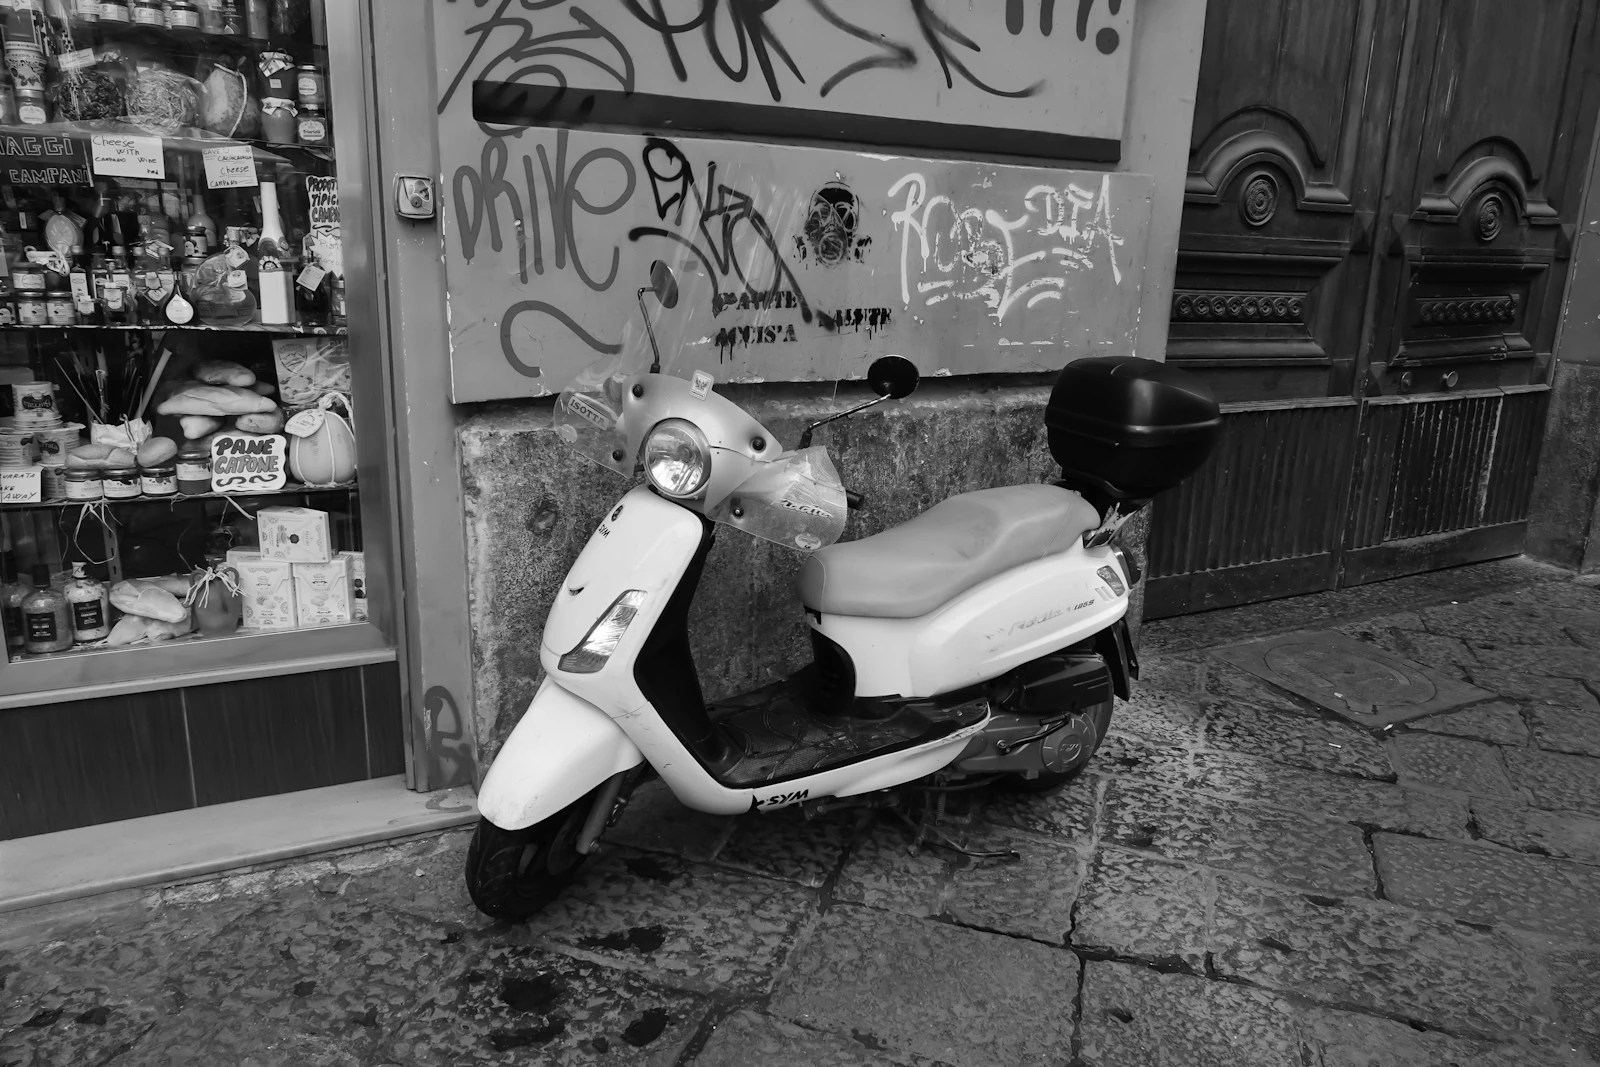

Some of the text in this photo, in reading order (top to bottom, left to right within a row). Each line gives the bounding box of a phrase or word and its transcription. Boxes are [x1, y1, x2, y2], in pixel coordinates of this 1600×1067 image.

[0, 133, 73, 155] AGGI
[93, 136, 135, 148] Cheese
[214, 437, 275, 455] PANE
[214, 454, 279, 474] CAFONE
[3, 492, 37, 500] AWAY
[766, 789, 809, 806] SYM
